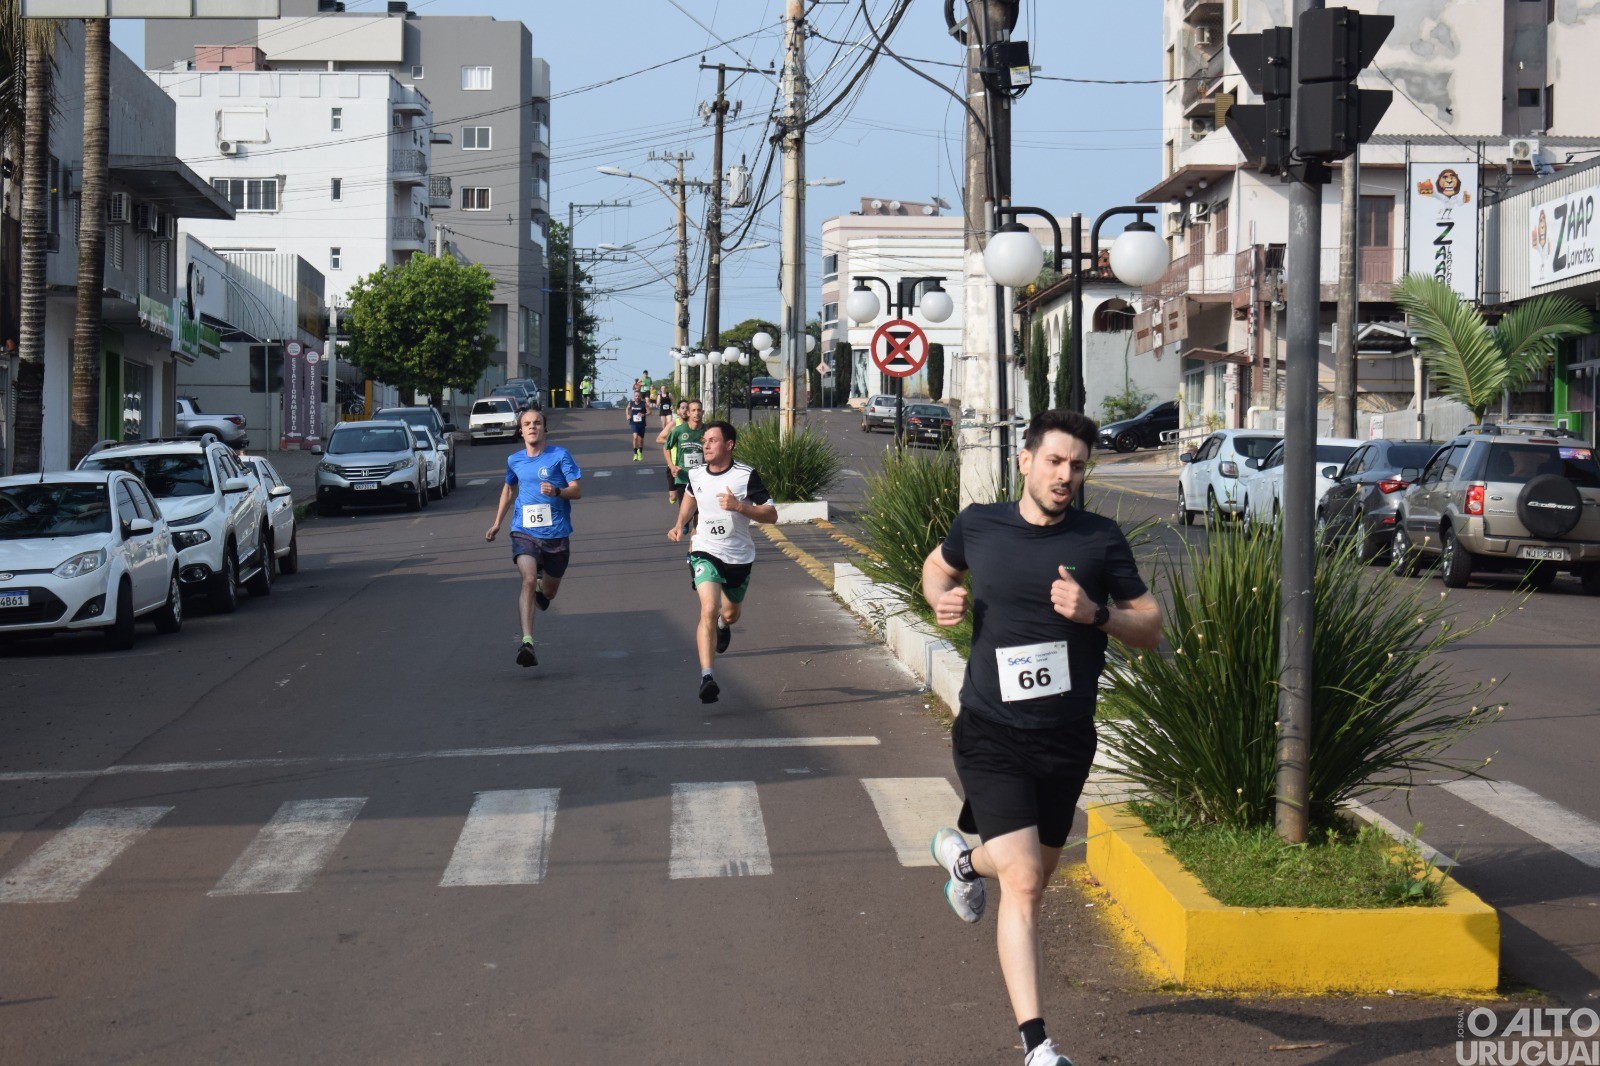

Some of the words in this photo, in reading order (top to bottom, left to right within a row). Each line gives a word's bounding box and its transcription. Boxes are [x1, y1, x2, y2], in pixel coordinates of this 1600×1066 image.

[1553, 195, 1594, 272] ZAAP
[1567, 242, 1594, 269] Lanches
[530, 514, 544, 523] 05
[710, 525, 726, 535] 48
[1018, 667, 1052, 690] 66
